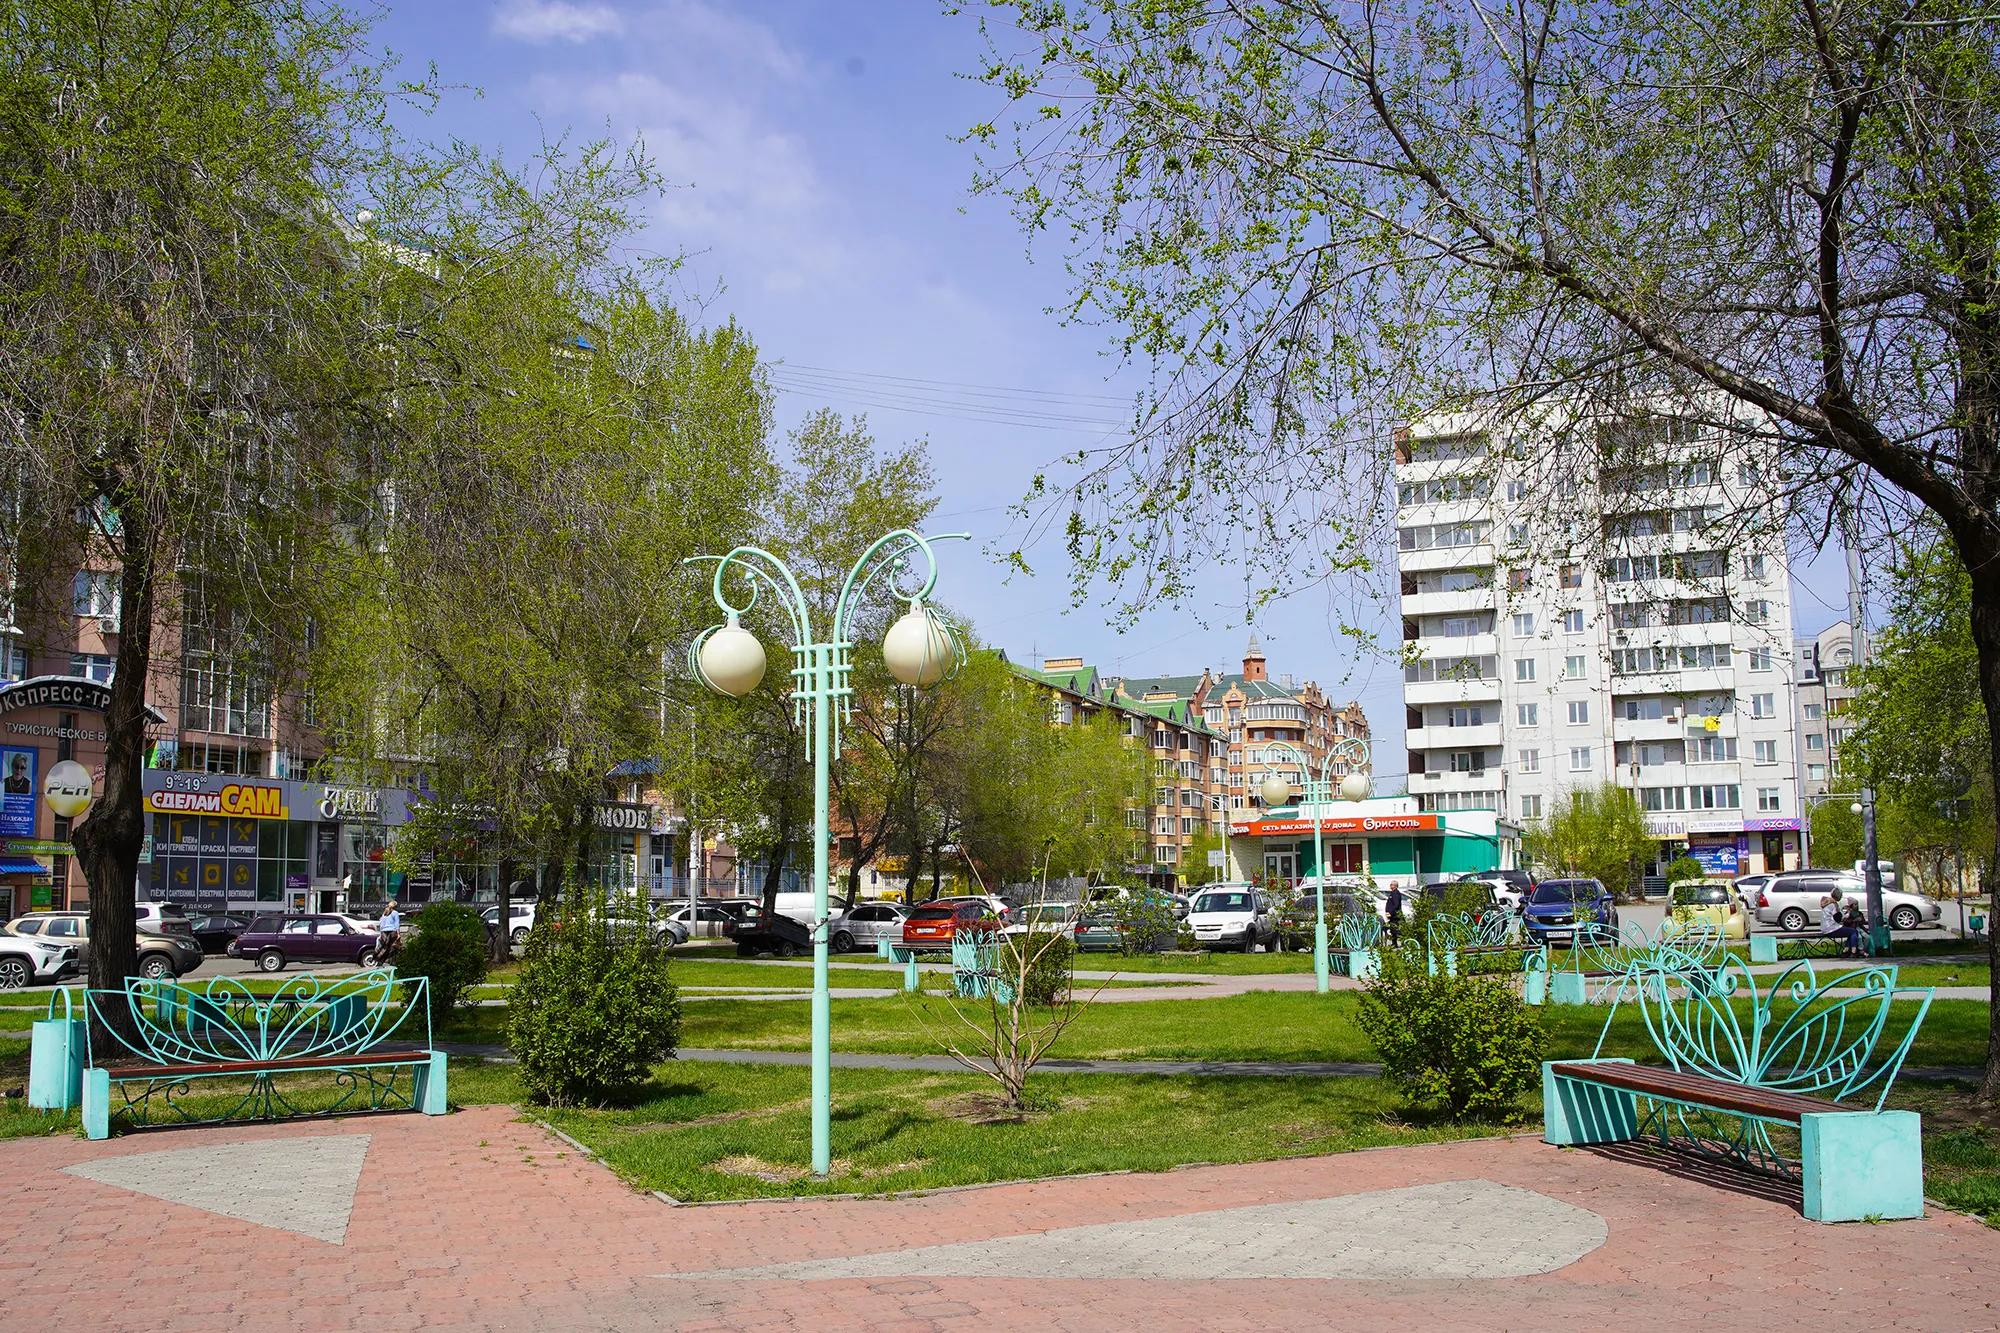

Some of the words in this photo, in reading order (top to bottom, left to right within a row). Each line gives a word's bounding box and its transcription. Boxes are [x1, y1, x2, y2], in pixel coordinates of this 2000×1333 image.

[0, 686, 111, 713] КСПРЕСС-ТР
[5, 722, 97, 740] ТУРИСТИЧЕСКОЕ
[151, 791, 220, 812] СДЕЛАЙ
[221, 784, 282, 815] САМ
[1280, 823, 1322, 831] МАГАЗИНО
[1332, 822, 1357, 830] ДОМА»
[1363, 817, 1421, 831] Бристоль
[1762, 821, 1793, 829] OZON
[200, 845, 226, 853] КРАСКА
[199, 889, 225, 897] ЭЛЕКТРИКА
